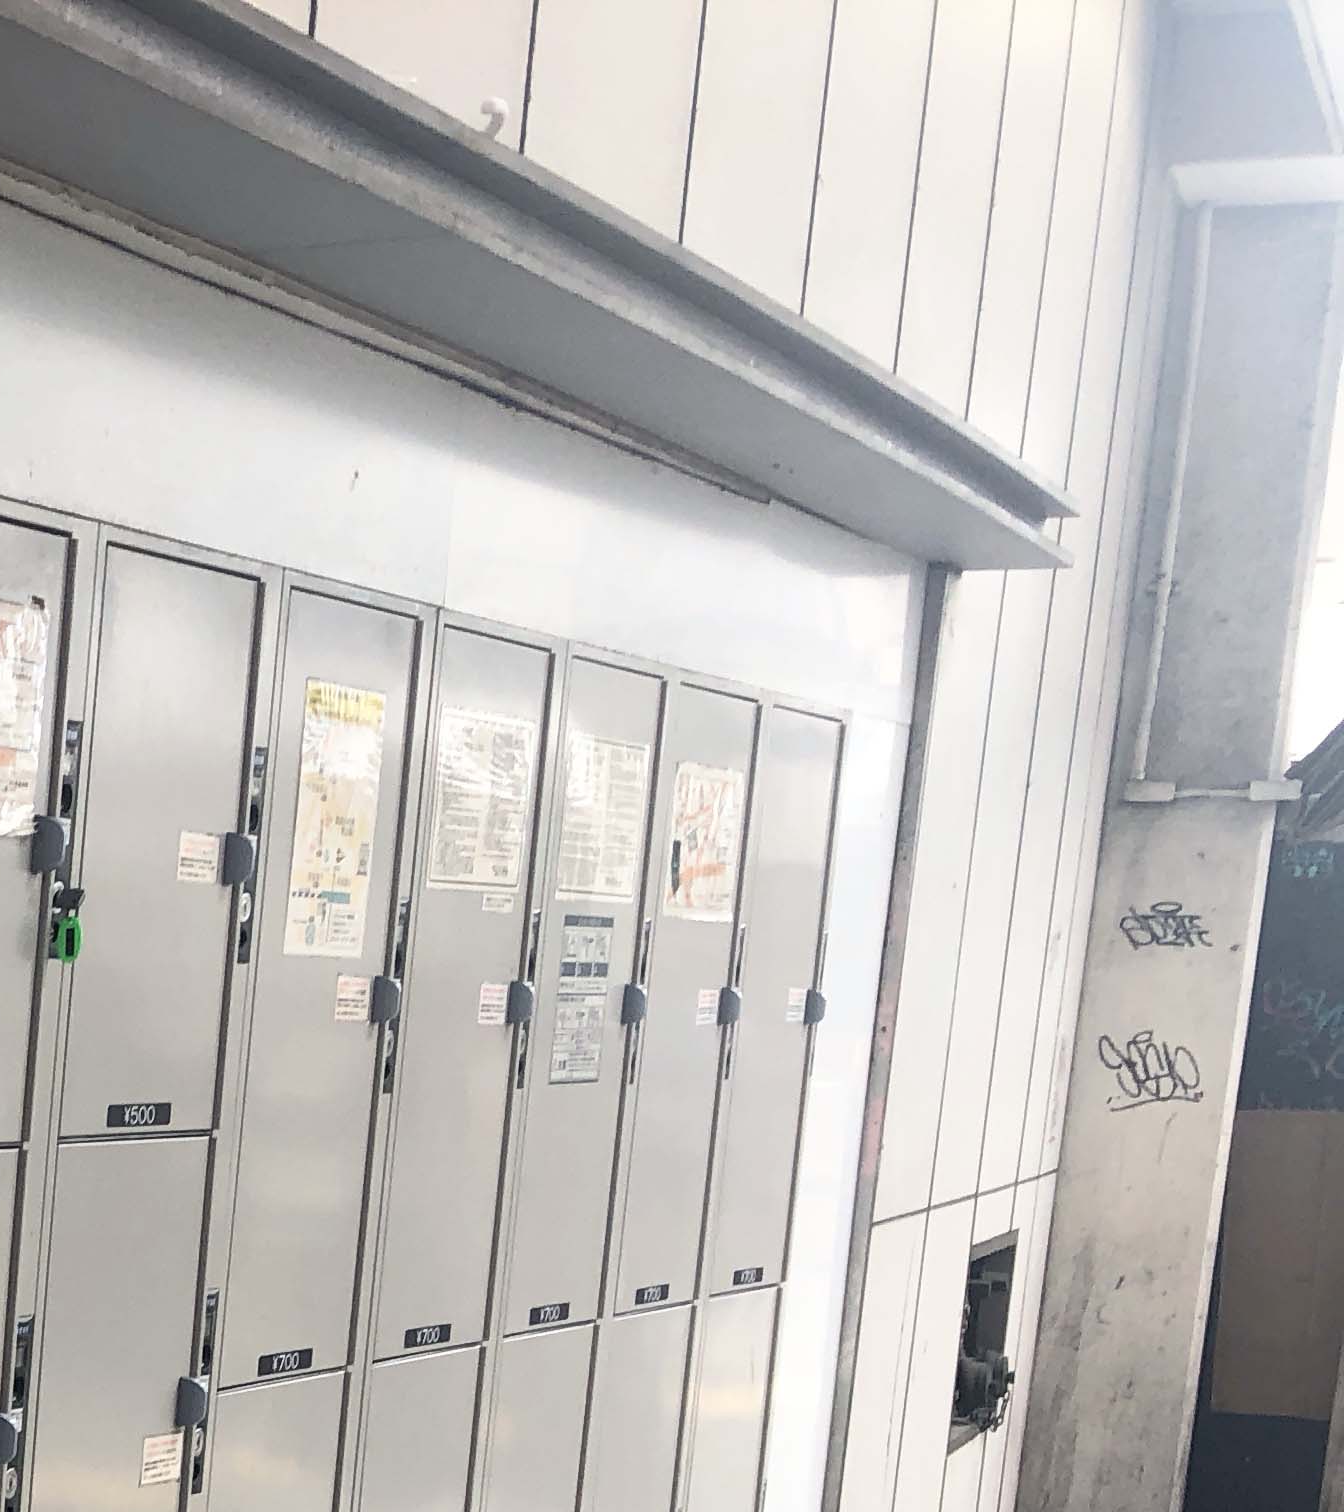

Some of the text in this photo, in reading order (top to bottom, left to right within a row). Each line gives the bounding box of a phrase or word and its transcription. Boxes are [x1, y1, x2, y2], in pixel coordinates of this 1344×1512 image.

[124, 1105, 156, 1125] ¥500
[416, 1327, 440, 1343] ¥700
[273, 1352, 300, 1371] ¥700
